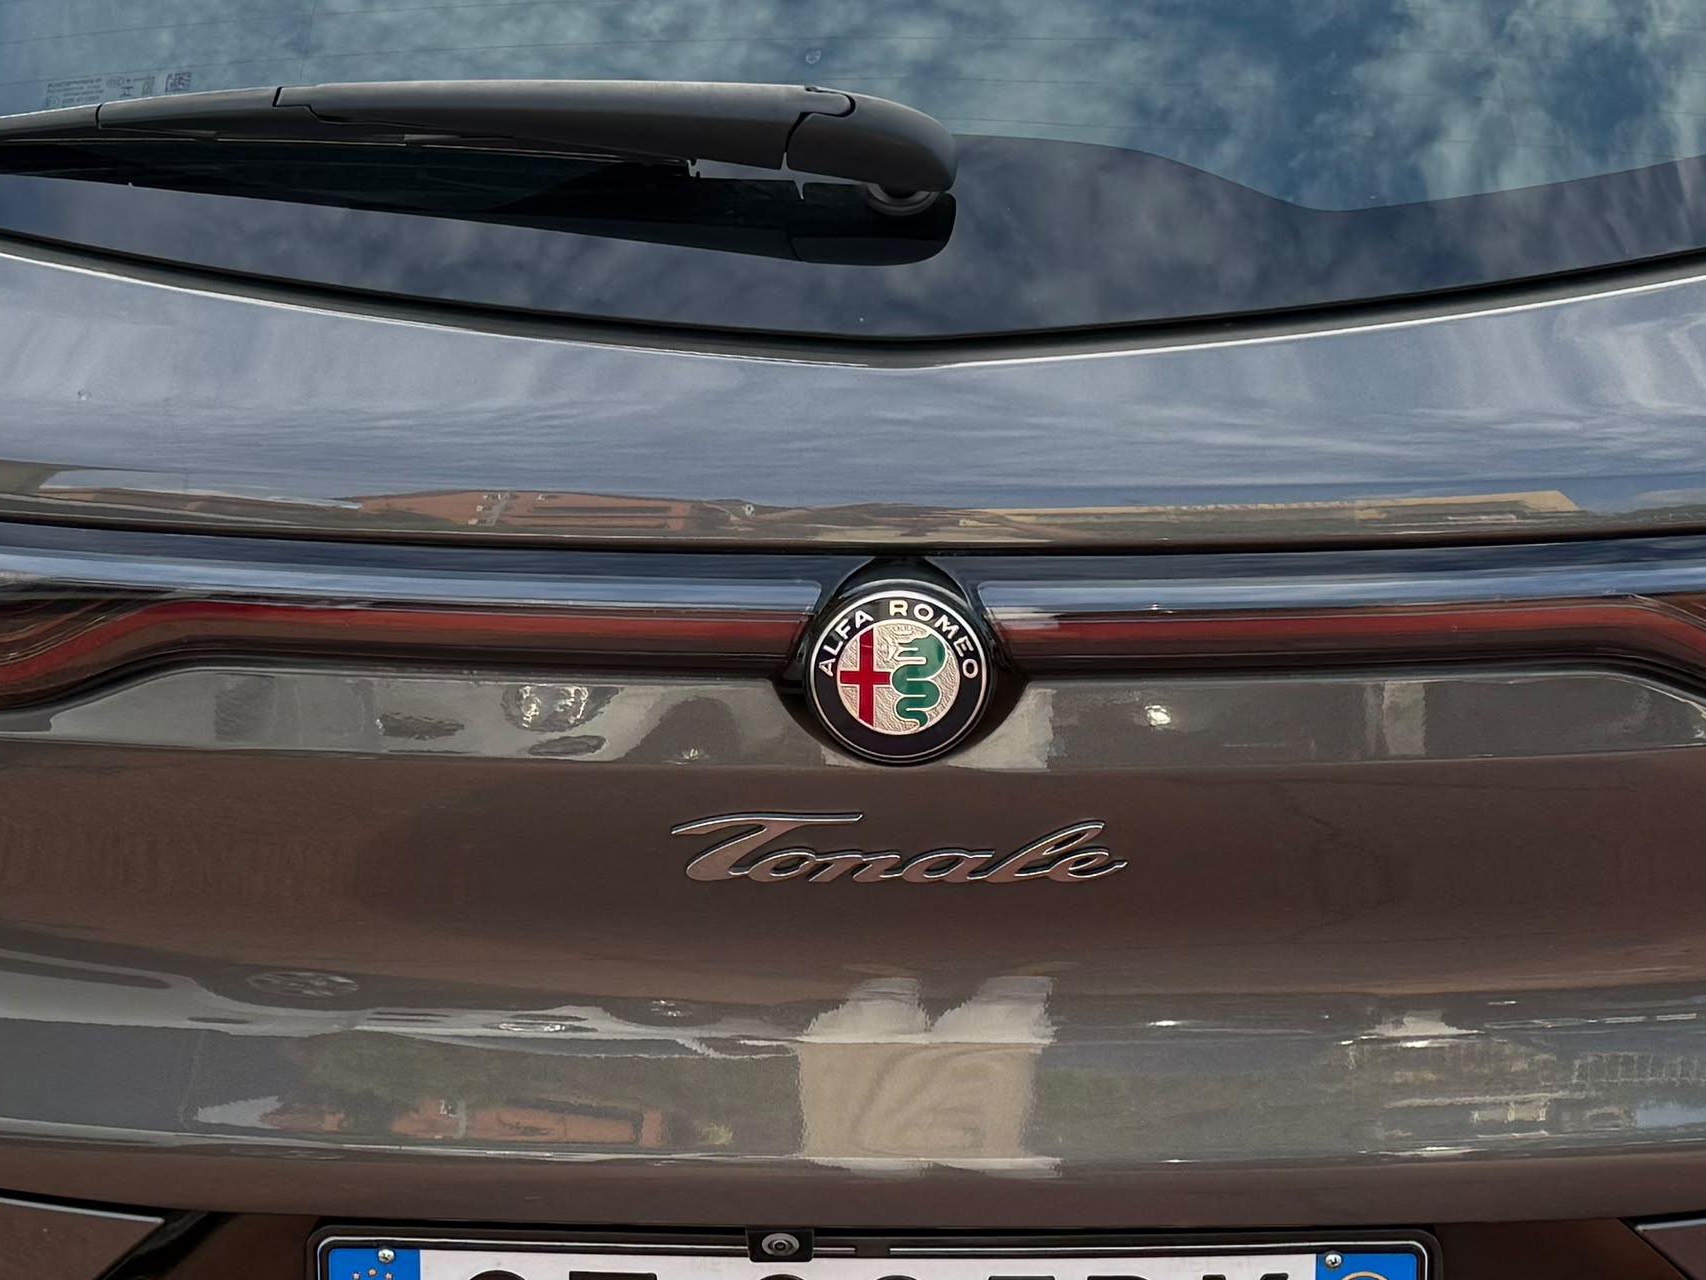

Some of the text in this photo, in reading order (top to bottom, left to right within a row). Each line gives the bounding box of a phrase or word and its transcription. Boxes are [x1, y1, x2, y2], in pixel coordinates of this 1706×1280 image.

[819, 599, 979, 679] ALFA ROMEO
[670, 810, 1129, 883] Tonale
